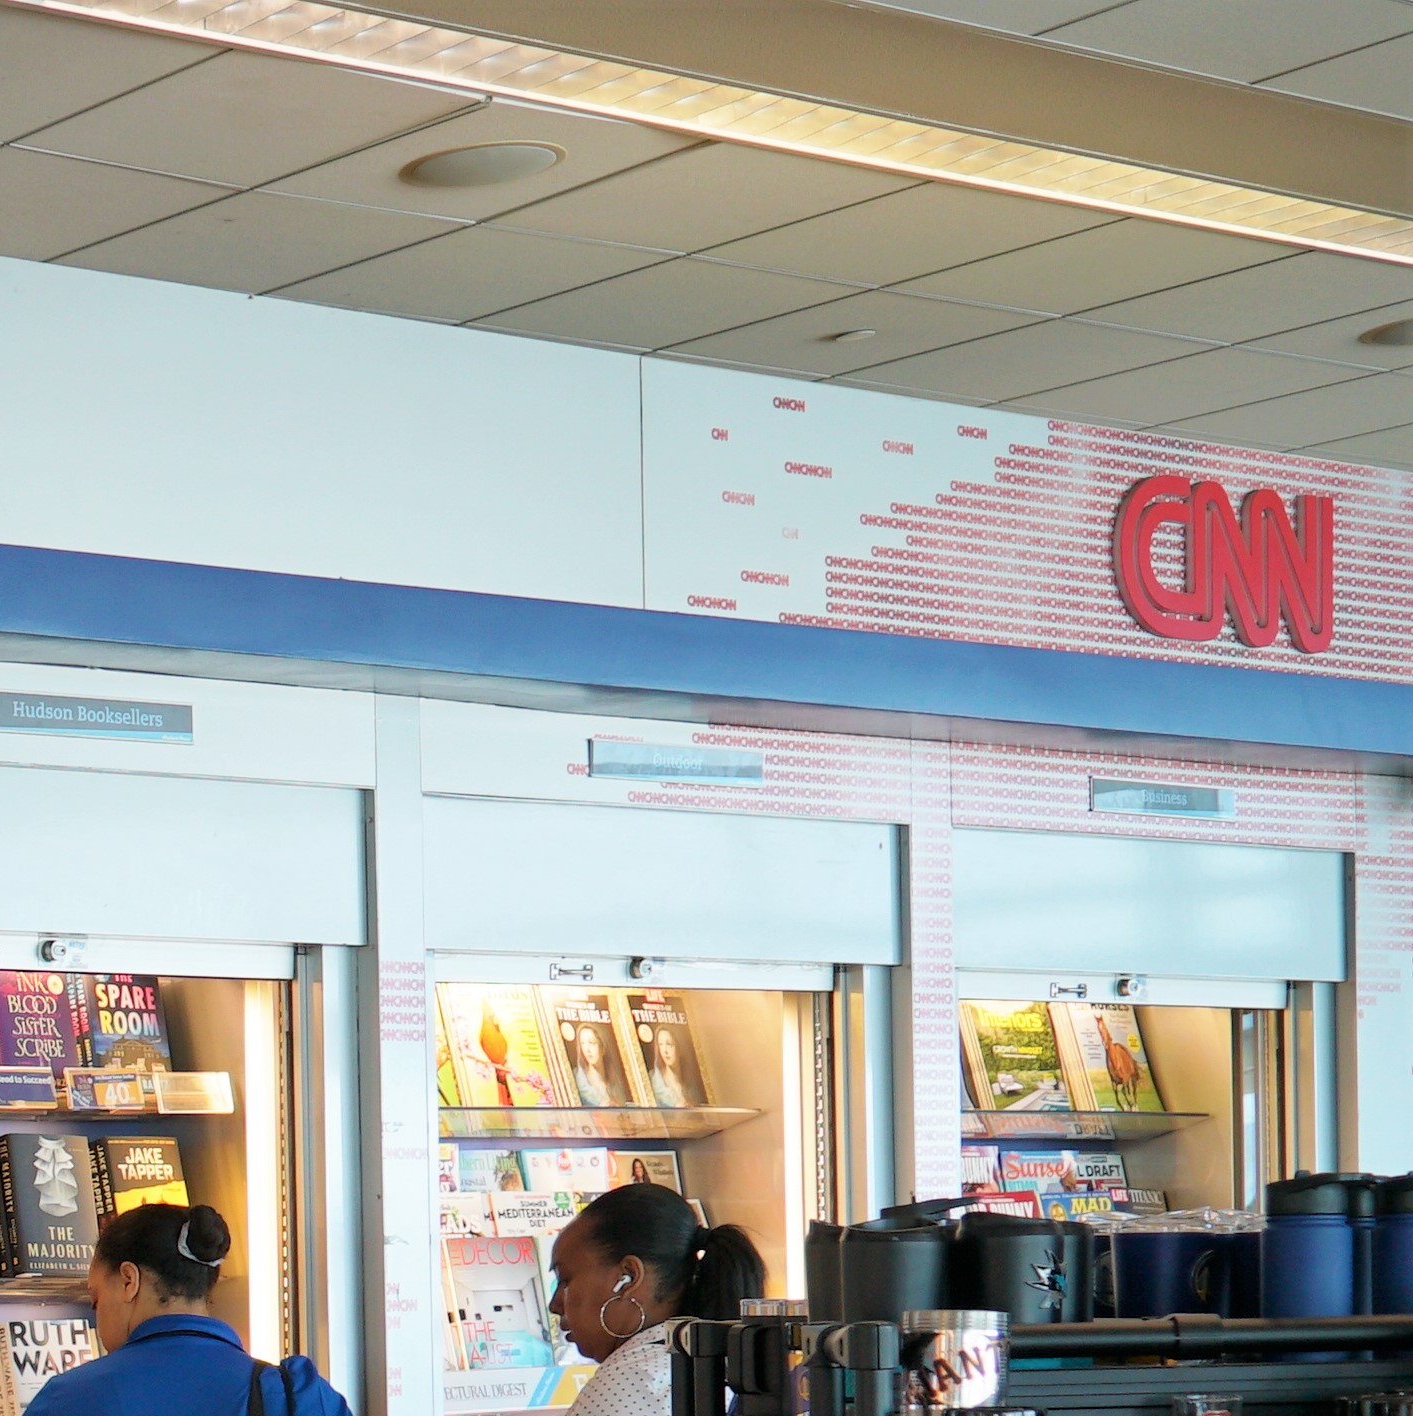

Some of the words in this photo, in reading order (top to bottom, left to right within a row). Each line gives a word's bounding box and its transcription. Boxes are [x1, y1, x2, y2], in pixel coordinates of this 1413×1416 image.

[1115, 475, 1333, 652] CNN
[13, 701, 73, 721] Hudson
[78, 706, 163, 727] Booksellers
[653, 754, 703, 770] Outdoor
[1142, 789, 1187, 806] Business
[7, 995, 57, 1014] BLOOD
[94, 983, 157, 1010] SPARE
[98, 1010, 161, 1036] ROOM
[556, 1008, 578, 1021] THE
[579, 1009, 611, 1023] BIBLE
[632, 1009, 657, 1022] THE
[657, 1011, 688, 1024] BIBLE
[980, 1010, 1043, 1030] Interiors
[22, 1075, 52, 1084] Succeed
[105, 1084, 129, 1105] 40
[125, 1147, 164, 1164] JAKE
[117, 1164, 174, 1181] TAPPER
[1085, 1162, 1121, 1178] DRAFT
[520, 1200, 548, 1208] SUMMER
[1111, 1189, 1129, 1202] LIFE
[497, 1207, 574, 1220] MEDITERRANEAN
[1071, 1197, 1112, 1213] MAD
[529, 1219, 547, 1228] DIET
[48, 1226, 75, 1241] THE
[27, 1242, 96, 1259] MAJORITY
[460, 1239, 536, 1266] DECOR
[9, 1320, 91, 1348] RUTH
[463, 1321, 497, 1343] THE
[493, 1383, 527, 1398] DIGEST
